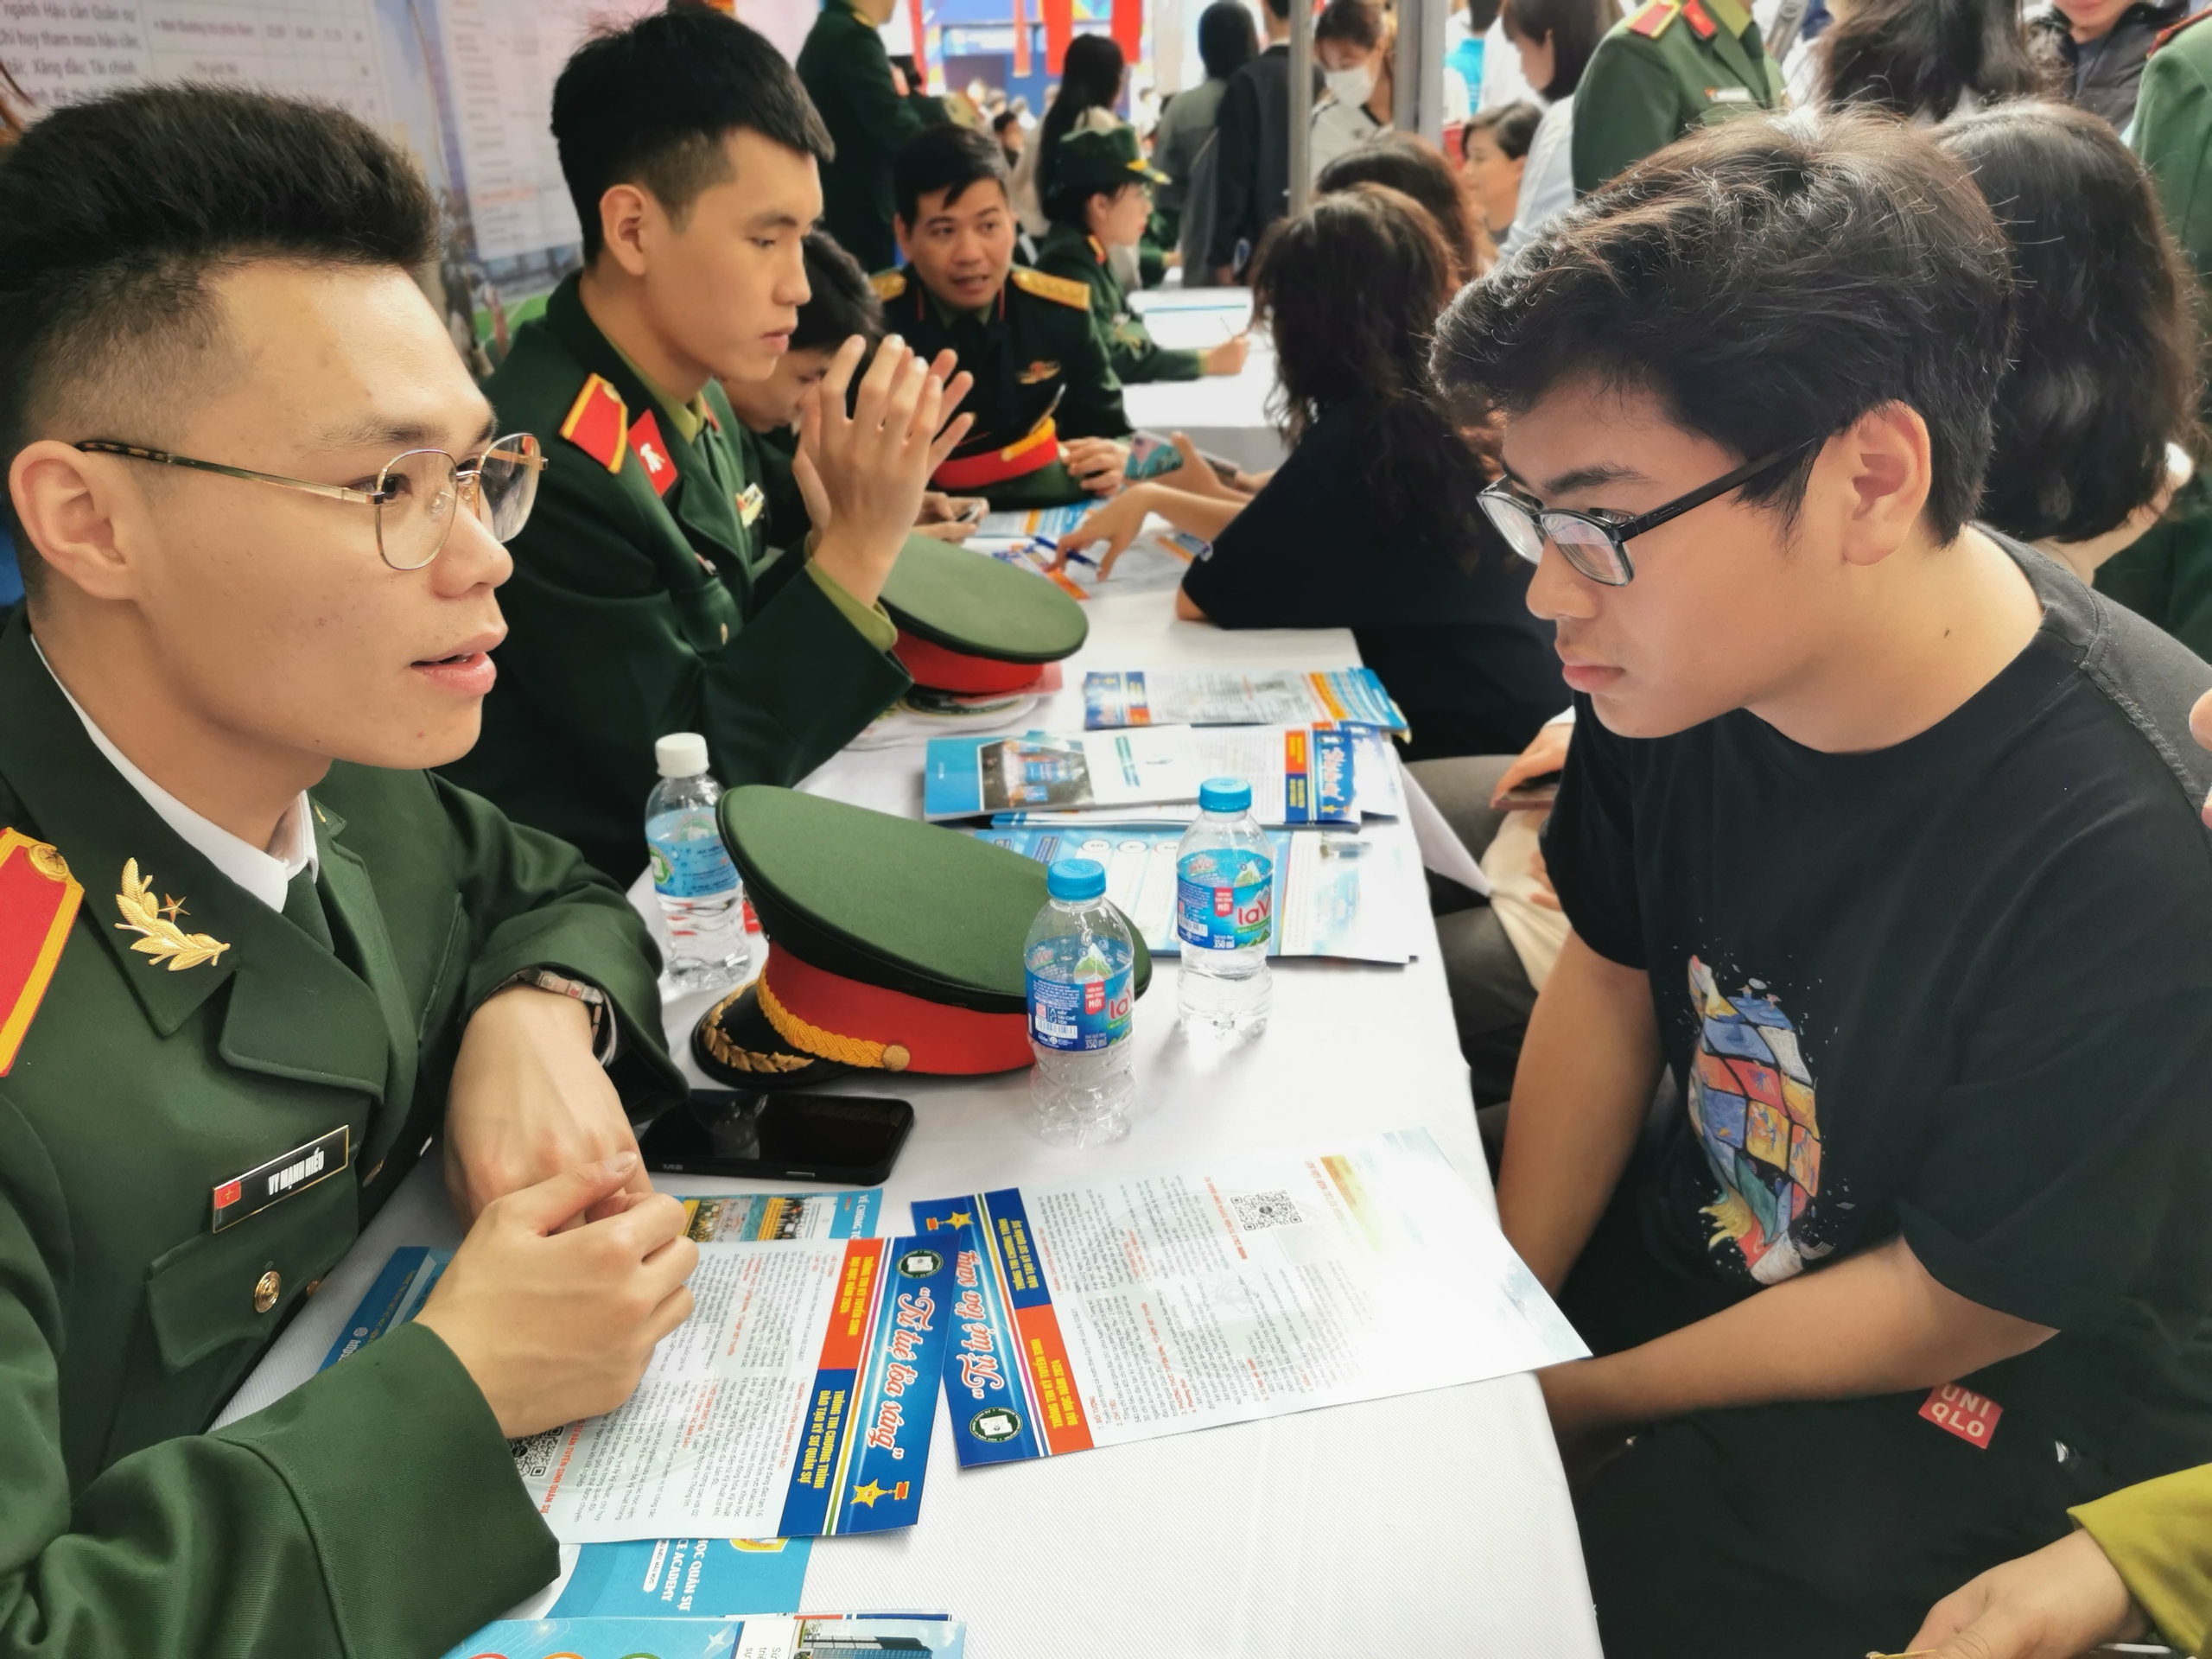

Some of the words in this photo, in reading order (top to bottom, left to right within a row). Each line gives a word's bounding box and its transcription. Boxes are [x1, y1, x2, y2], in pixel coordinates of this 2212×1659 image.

[1214, 939, 1225, 949] 350
[1226, 939, 1235, 948] ml
[1089, 999, 1102, 1009] MỚI
[1085, 1039, 1097, 1049] 350
[1098, 1037, 1107, 1047] ml
[1014, 1228, 1026, 1245] QUÂN
[1009, 1259, 1019, 1269] TIN
[1023, 1262, 1034, 1274] TẠO
[859, 1276, 869, 1287] TIN
[1012, 1270, 1025, 1290] THÔNG
[1027, 1275, 1038, 1287] ĐÀO
[955, 1291, 986, 1320] tỏa
[886, 1329, 923, 1360] tuệ
[961, 1324, 995, 1352] tuệ
[1031, 1338, 1044, 1356] SINH
[1033, 1356, 1050, 1379] TUYỂN
[1051, 1359, 1065, 1376] 2024
[885, 1363, 918, 1396] tỏa
[1055, 1377, 1069, 1395] NĂM
[817, 1390, 830, 1405] ĐÀO
[830, 1390, 845, 1414] THÔNG
[1044, 1389, 1056, 1402] TIN
[1060, 1395, 1074, 1411] HỌC
[1941, 1384, 1991, 1418] UNI
[814, 1407, 827, 1421] TẠO
[828, 1416, 839, 1428] TIN
[1047, 1402, 1063, 1428] THÔNG
[1065, 1412, 1078, 1426] ĐẠI
[1931, 1402, 1985, 1438] QLO
[811, 1422, 823, 1433] KỸ
[868, 1401, 904, 1459] sáng”
[808, 1435, 820, 1446] SƯ
[819, 1430, 836, 1462] CHƯƠNG
[559, 1446, 574, 1466] TUYỂN
[803, 1447, 817, 1470] QUÂN
[553, 1467, 565, 1483] SINH
[798, 1471, 812, 1484] SỰ
[814, 1464, 829, 1488] TRÌNH
[545, 1484, 558, 1502] QUÂN
[539, 1504, 550, 1514] SỰ
[661, 1552, 685, 1601] ACADEMY
[683, 1560, 702, 1593] QUÂN
[677, 1595, 693, 1611] SỰ
